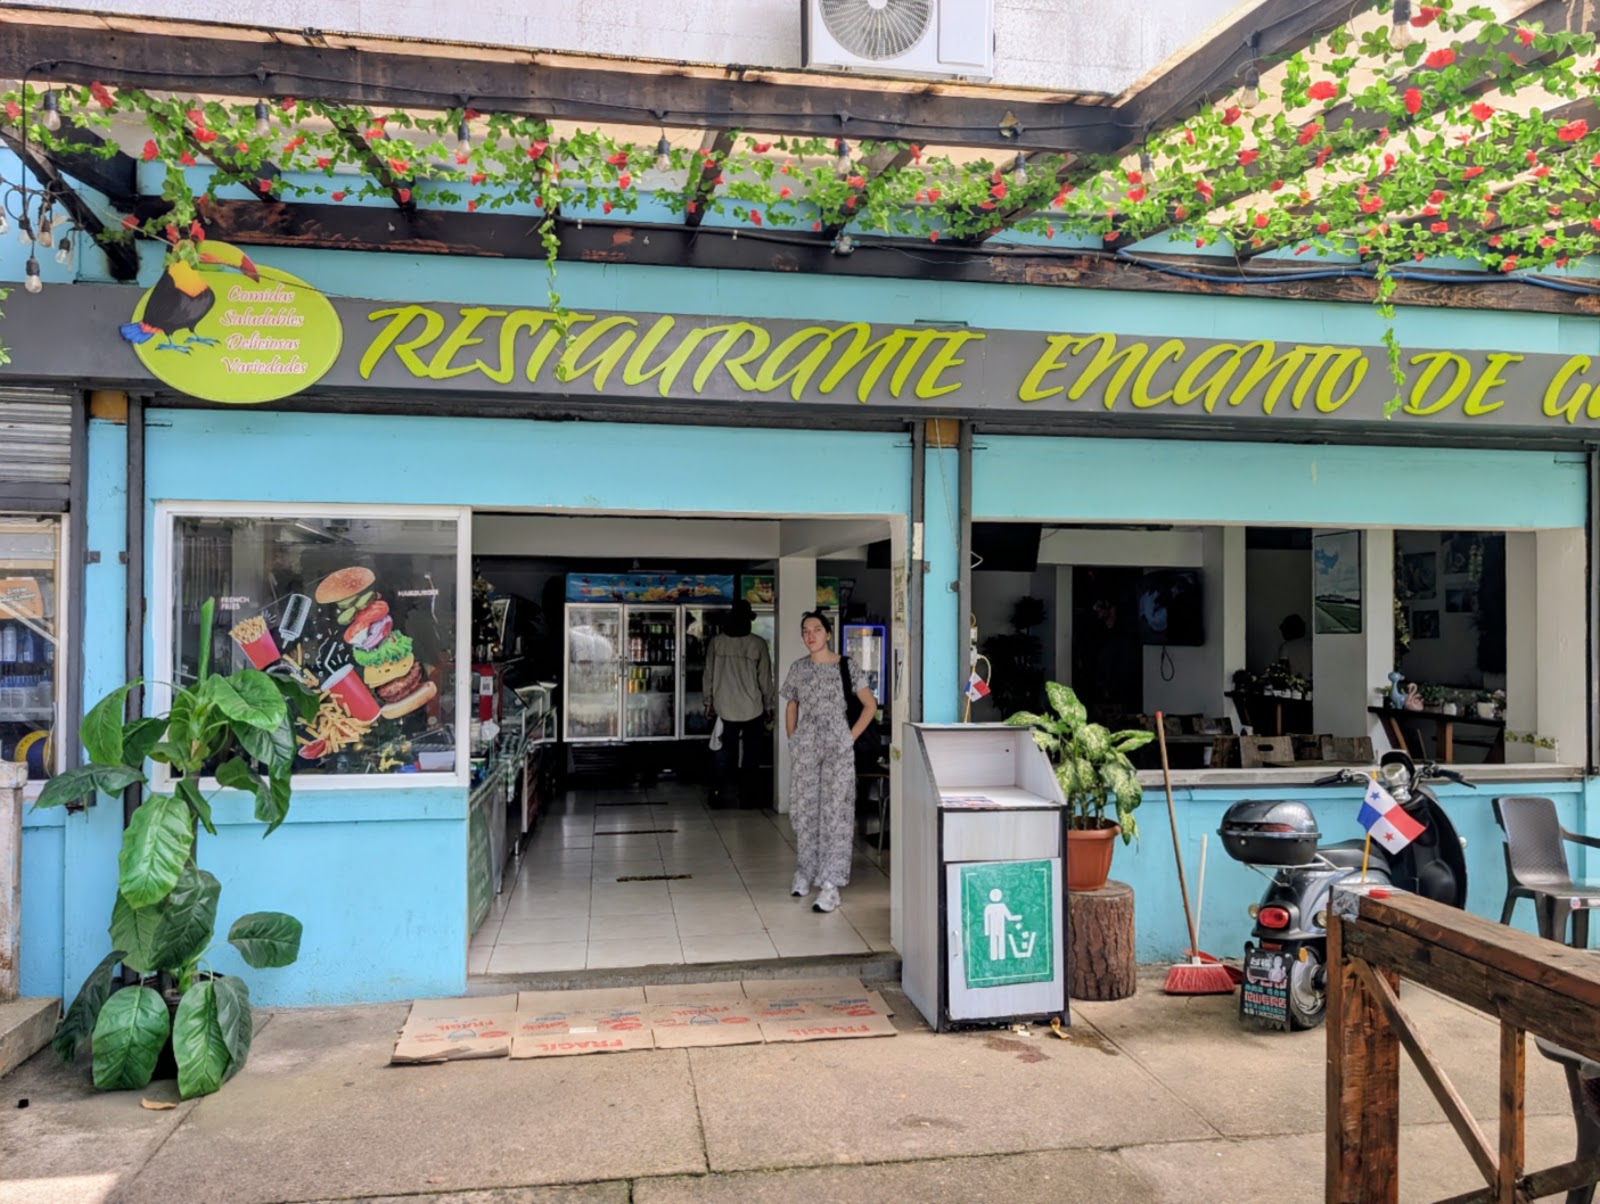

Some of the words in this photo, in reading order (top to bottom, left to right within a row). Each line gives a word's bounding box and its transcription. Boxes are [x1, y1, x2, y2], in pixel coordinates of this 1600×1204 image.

[228, 284, 294, 303] Comidas
[220, 307, 303, 326] Saludables
[227, 331, 299, 349] Deliciosas
[222, 355, 307, 374] Variedades
[360, 305, 986, 404] RESTAURANTE
[1019, 332, 1370, 415] ENCANTO
[1404, 350, 1524, 416] DE
[221, 596, 250, 604] FRENCH
[787, 1025, 870, 1036] FRAGIL
[535, 1039, 624, 1051] FRAGIL
